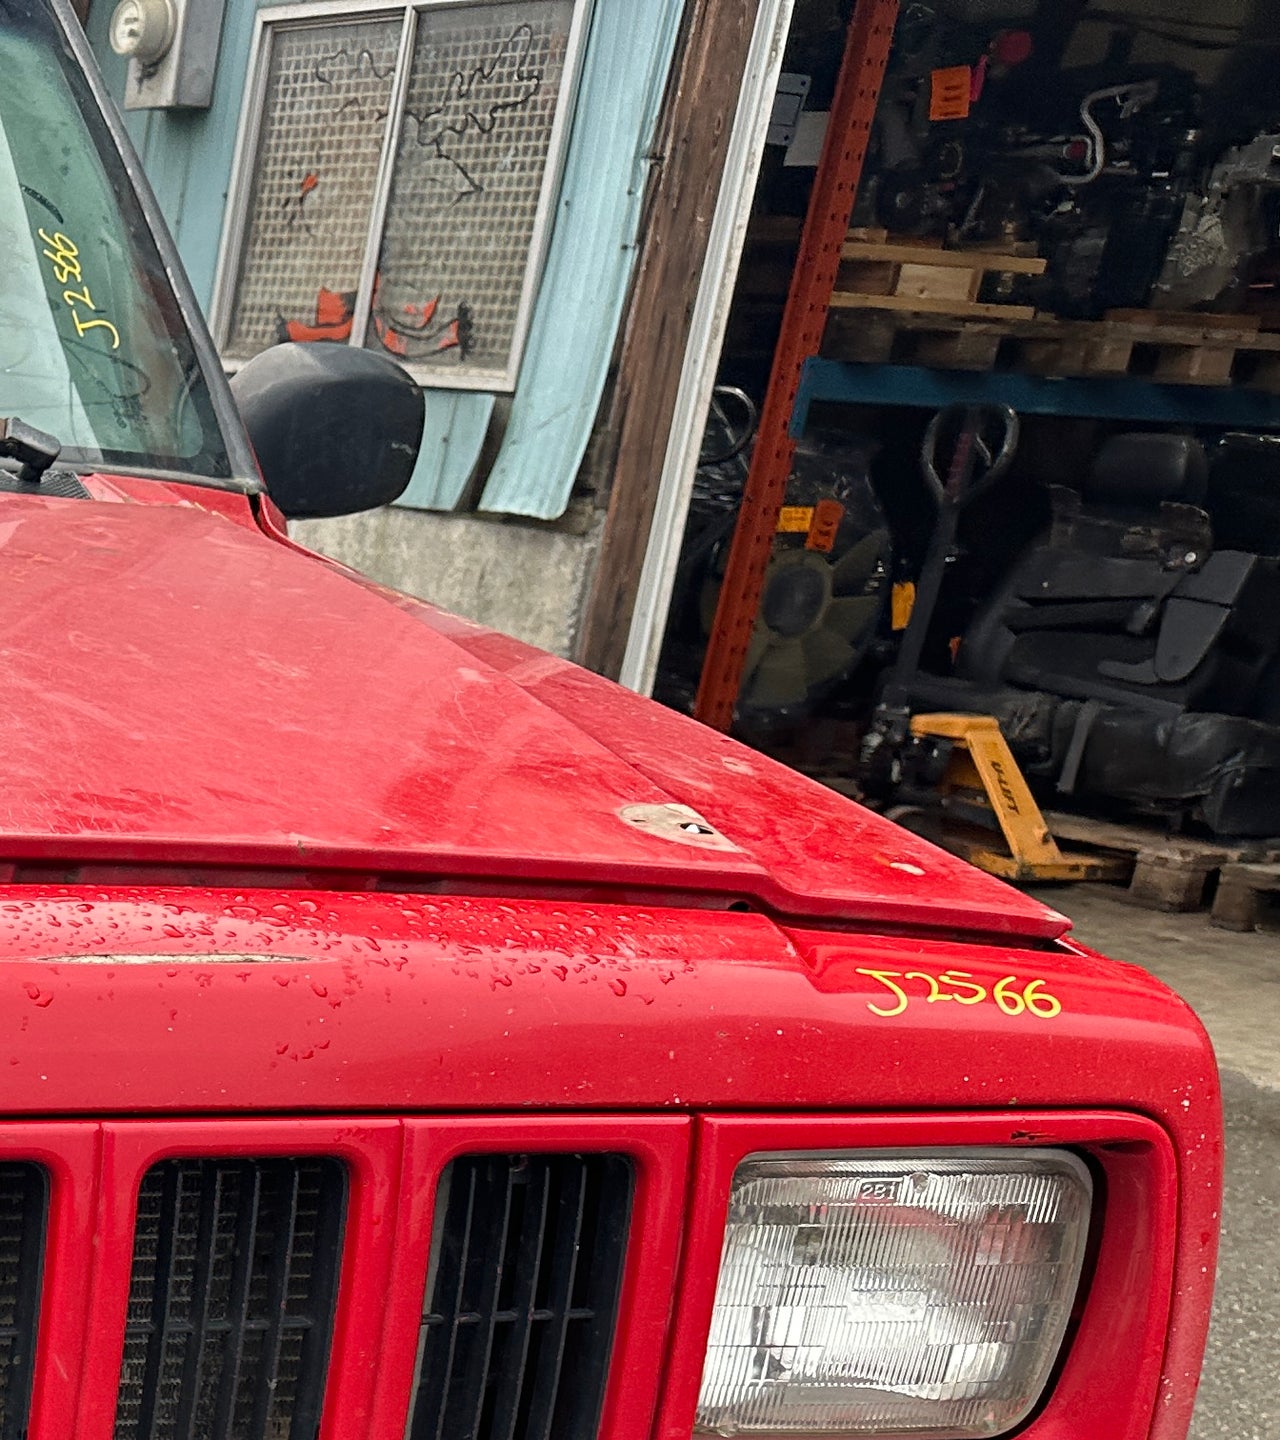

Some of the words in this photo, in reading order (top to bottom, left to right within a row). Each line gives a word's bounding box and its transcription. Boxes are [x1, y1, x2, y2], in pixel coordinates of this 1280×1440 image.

[38, 228, 121, 350] J2566
[855, 967, 1062, 1018] J2566
[861, 1181, 896, 1200] 2B1
